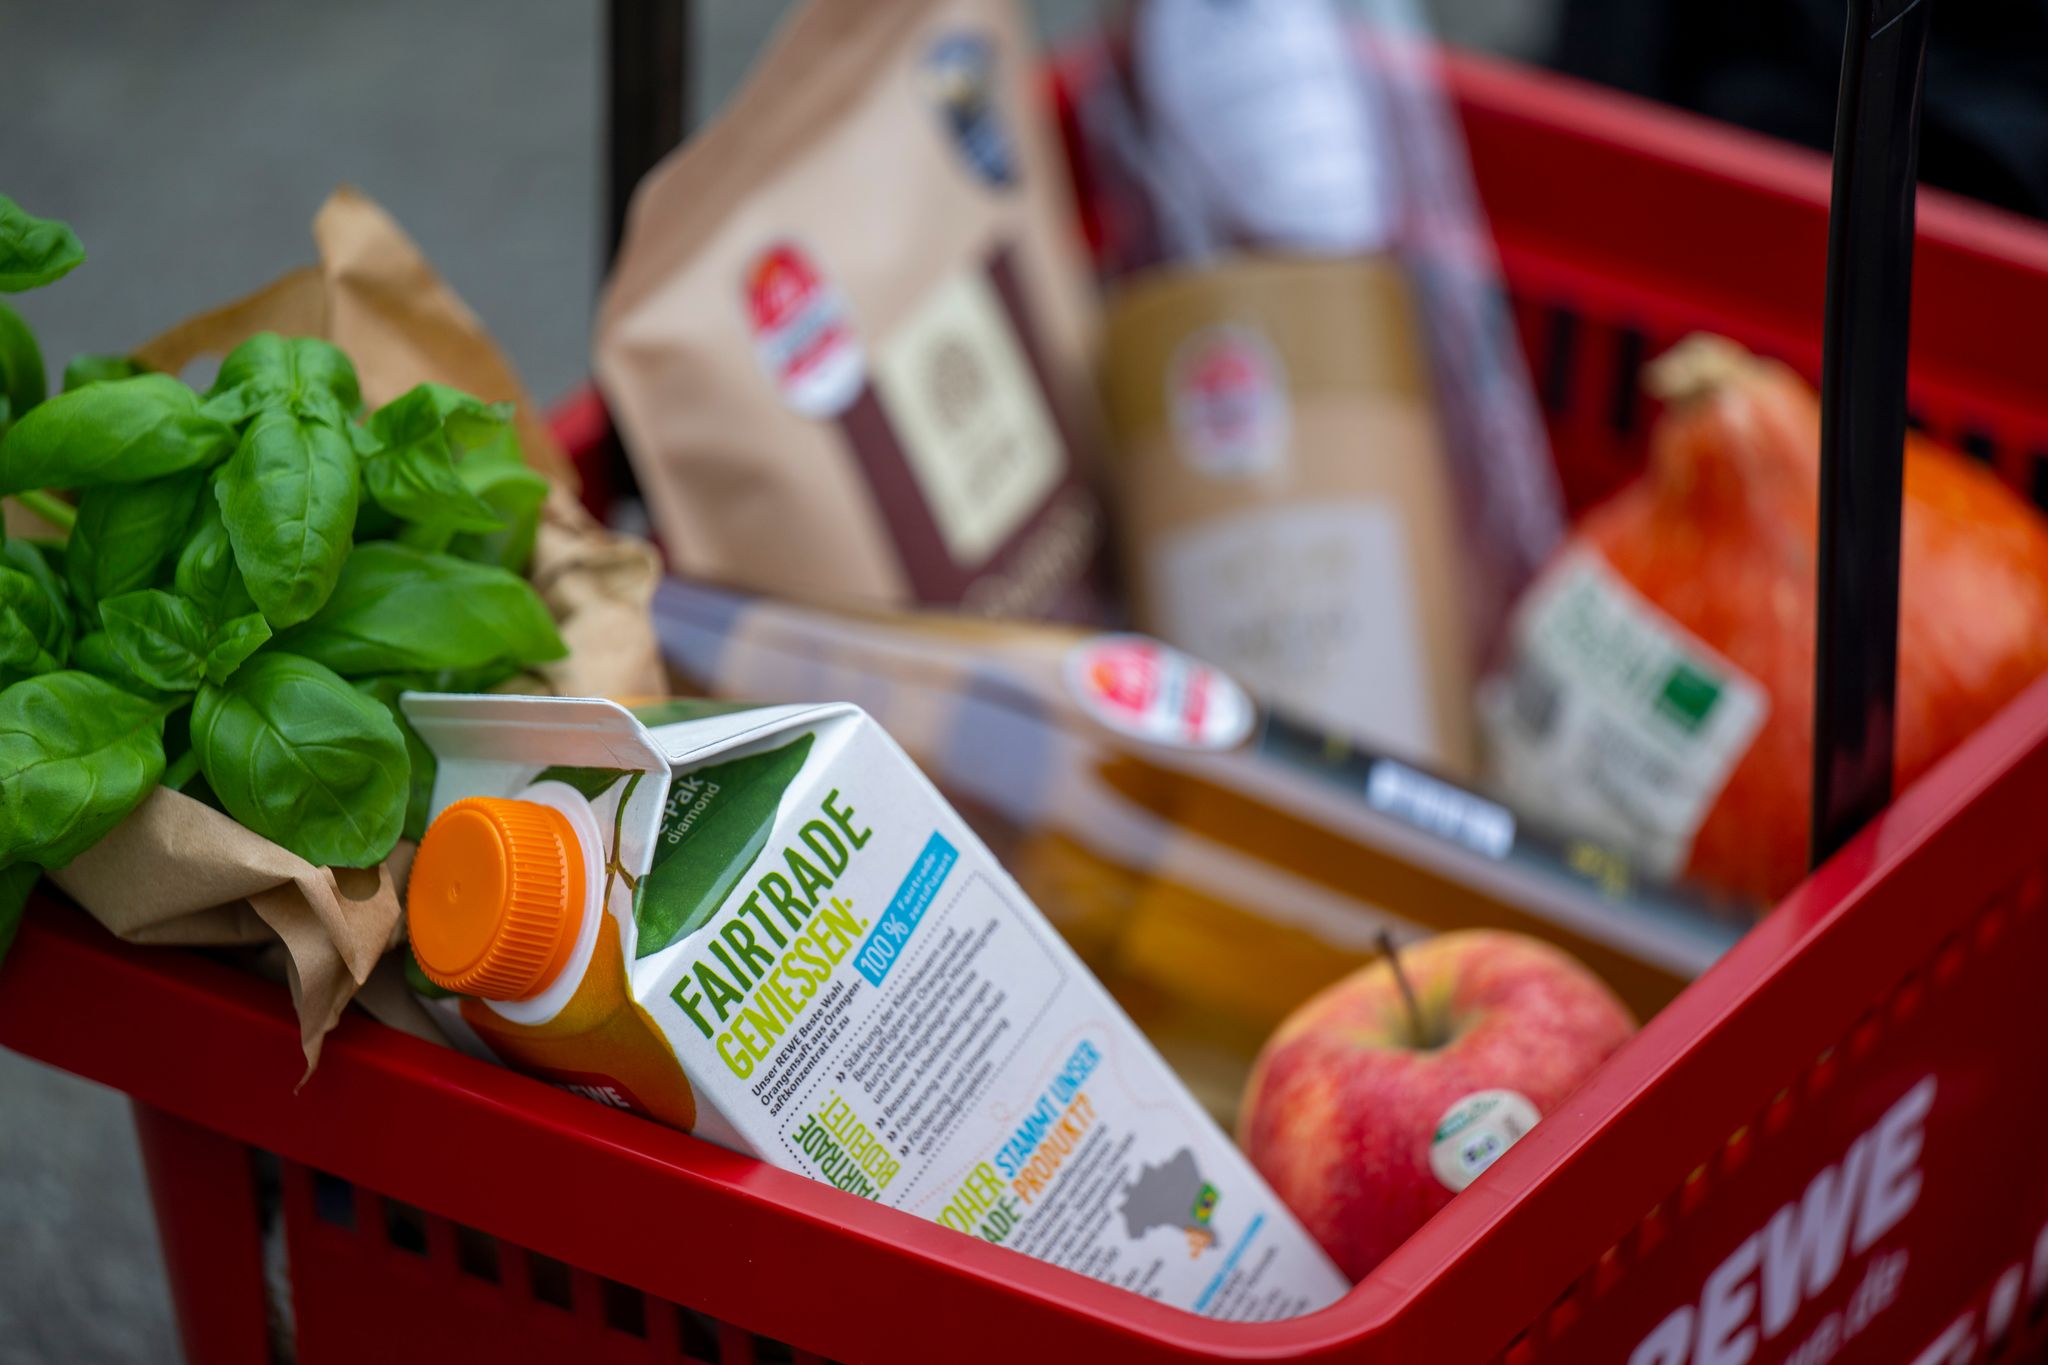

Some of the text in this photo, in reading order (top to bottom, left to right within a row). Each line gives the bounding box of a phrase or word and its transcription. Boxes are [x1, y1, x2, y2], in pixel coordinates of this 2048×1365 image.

[667, 782, 721, 845] diamond
[669, 788, 873, 1040] FAIRTRADE
[861, 913, 909, 977] 100 %
[715, 896, 869, 1080] GENIESSEN:
[752, 981, 844, 1096] Unser REWE Beste Wahl
[761, 980, 861, 1105] Orangensaft aus Orangen-
[770, 1016, 850, 1116] saftkonzentrat ist zu
[843, 1025, 883, 1071] Stärkung
[880, 1008, 894, 1026] der
[852, 1014, 908, 1082] Beschäftigten
[864, 1063, 888, 1093] durch
[818, 1089, 901, 1190] BEDEUTET:
[873, 1080, 891, 1104] und
[936, 1162, 1007, 1234] OHER
[994, 1096, 1059, 1179] STAMMT
[1051, 1040, 1100, 1105] UNSER
[792, 1113, 881, 1202] AIRTRADE
[975, 1093, 1097, 1244] ADE-PRODUKT?
